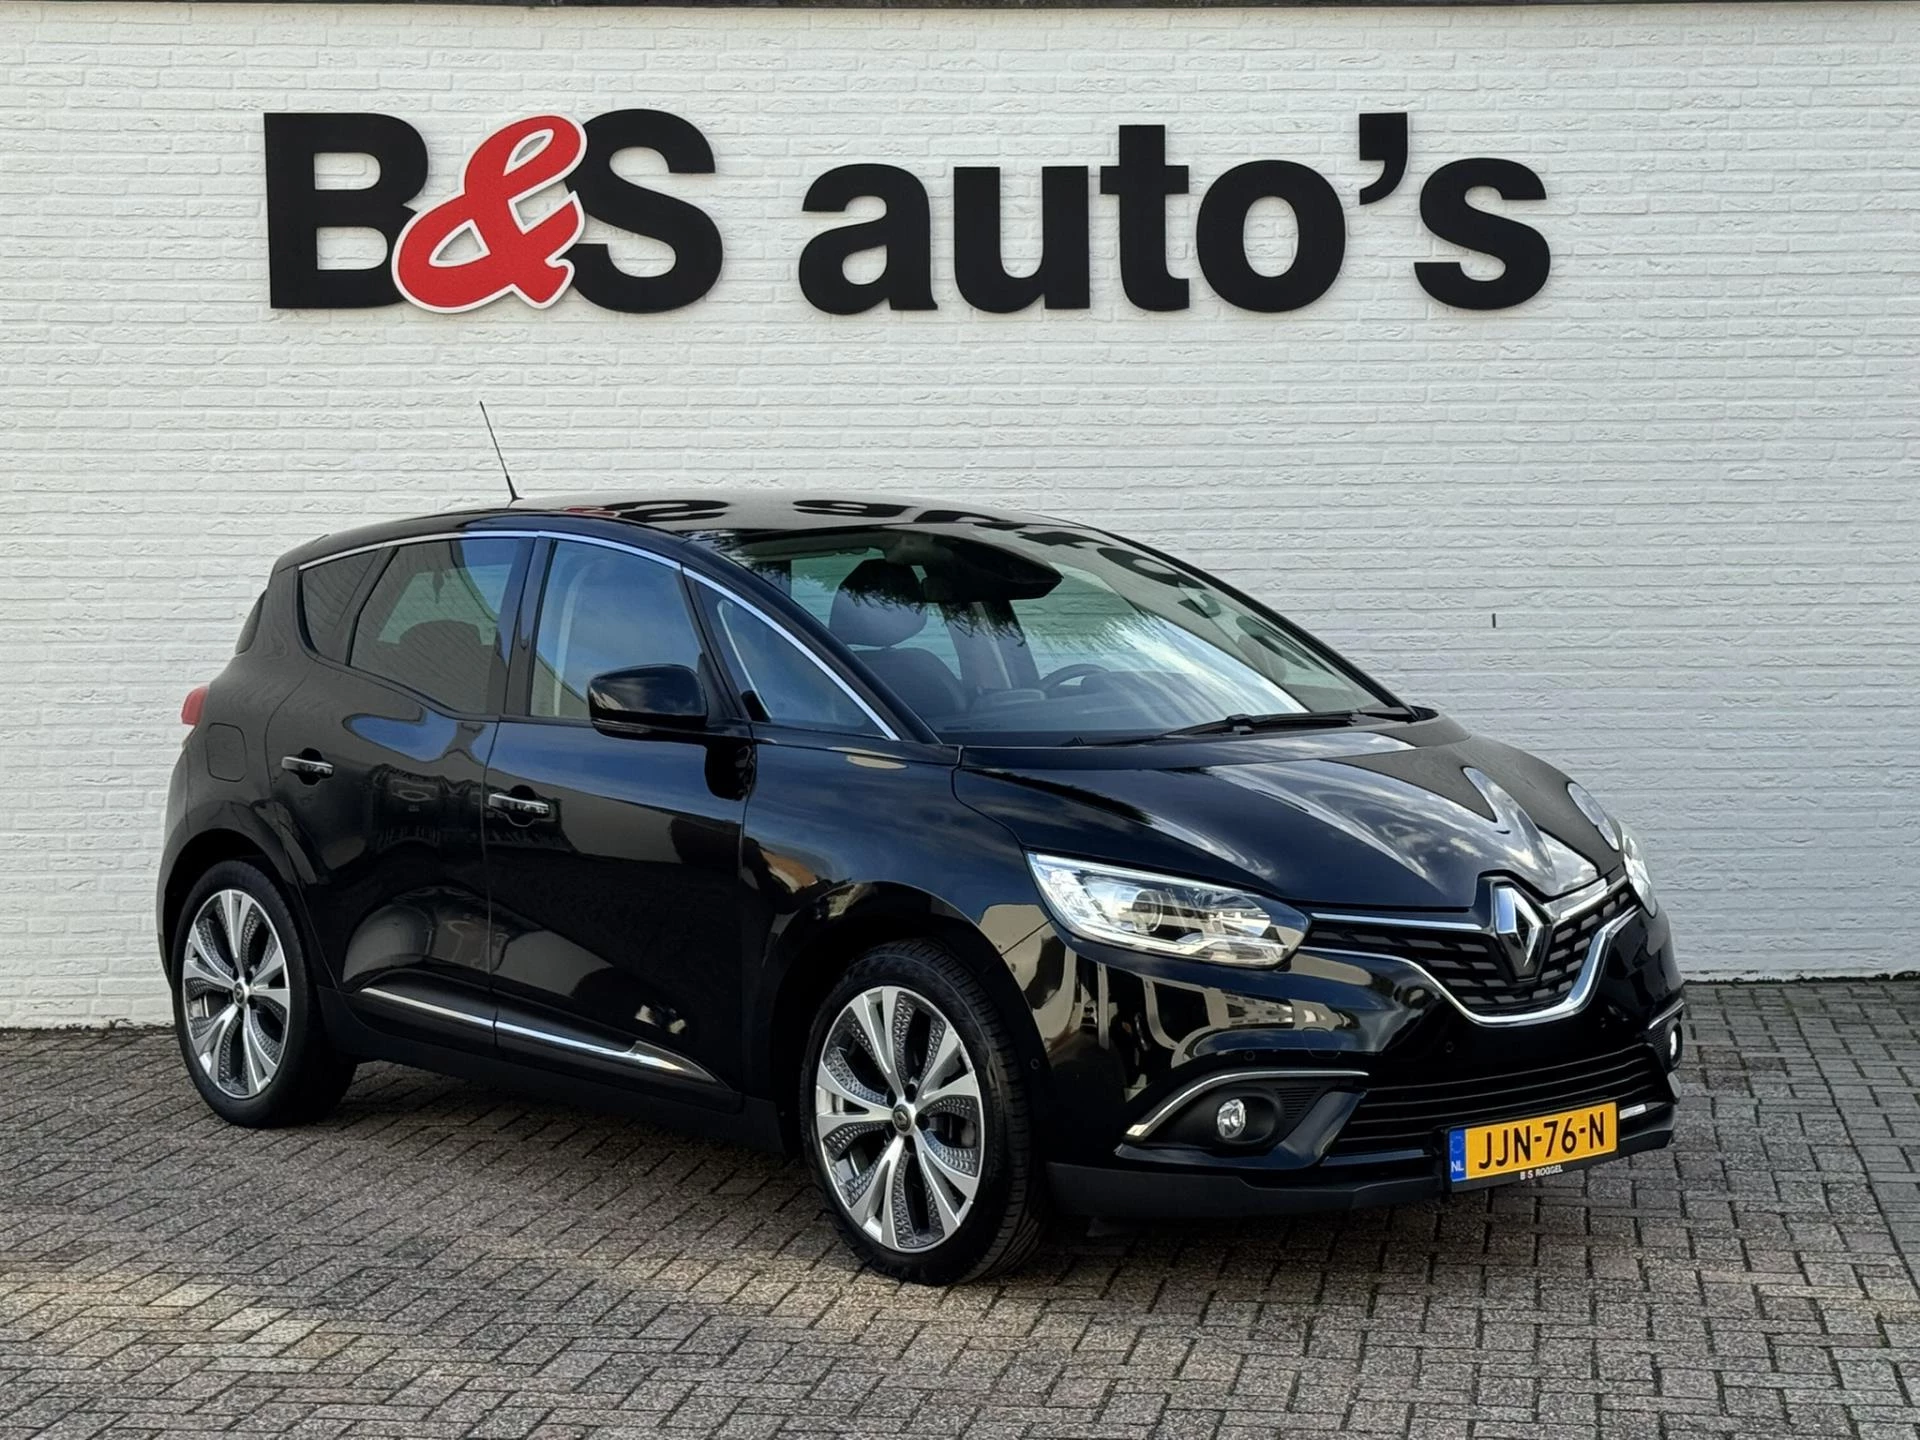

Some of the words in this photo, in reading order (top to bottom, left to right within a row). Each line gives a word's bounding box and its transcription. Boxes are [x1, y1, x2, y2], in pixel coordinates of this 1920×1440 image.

[264, 109, 723, 315] B&S
[798, 112, 1551, 315] auto's
[1450, 1160, 1464, 1173] NL
[1478, 1112, 1605, 1170] JJN-76-N
